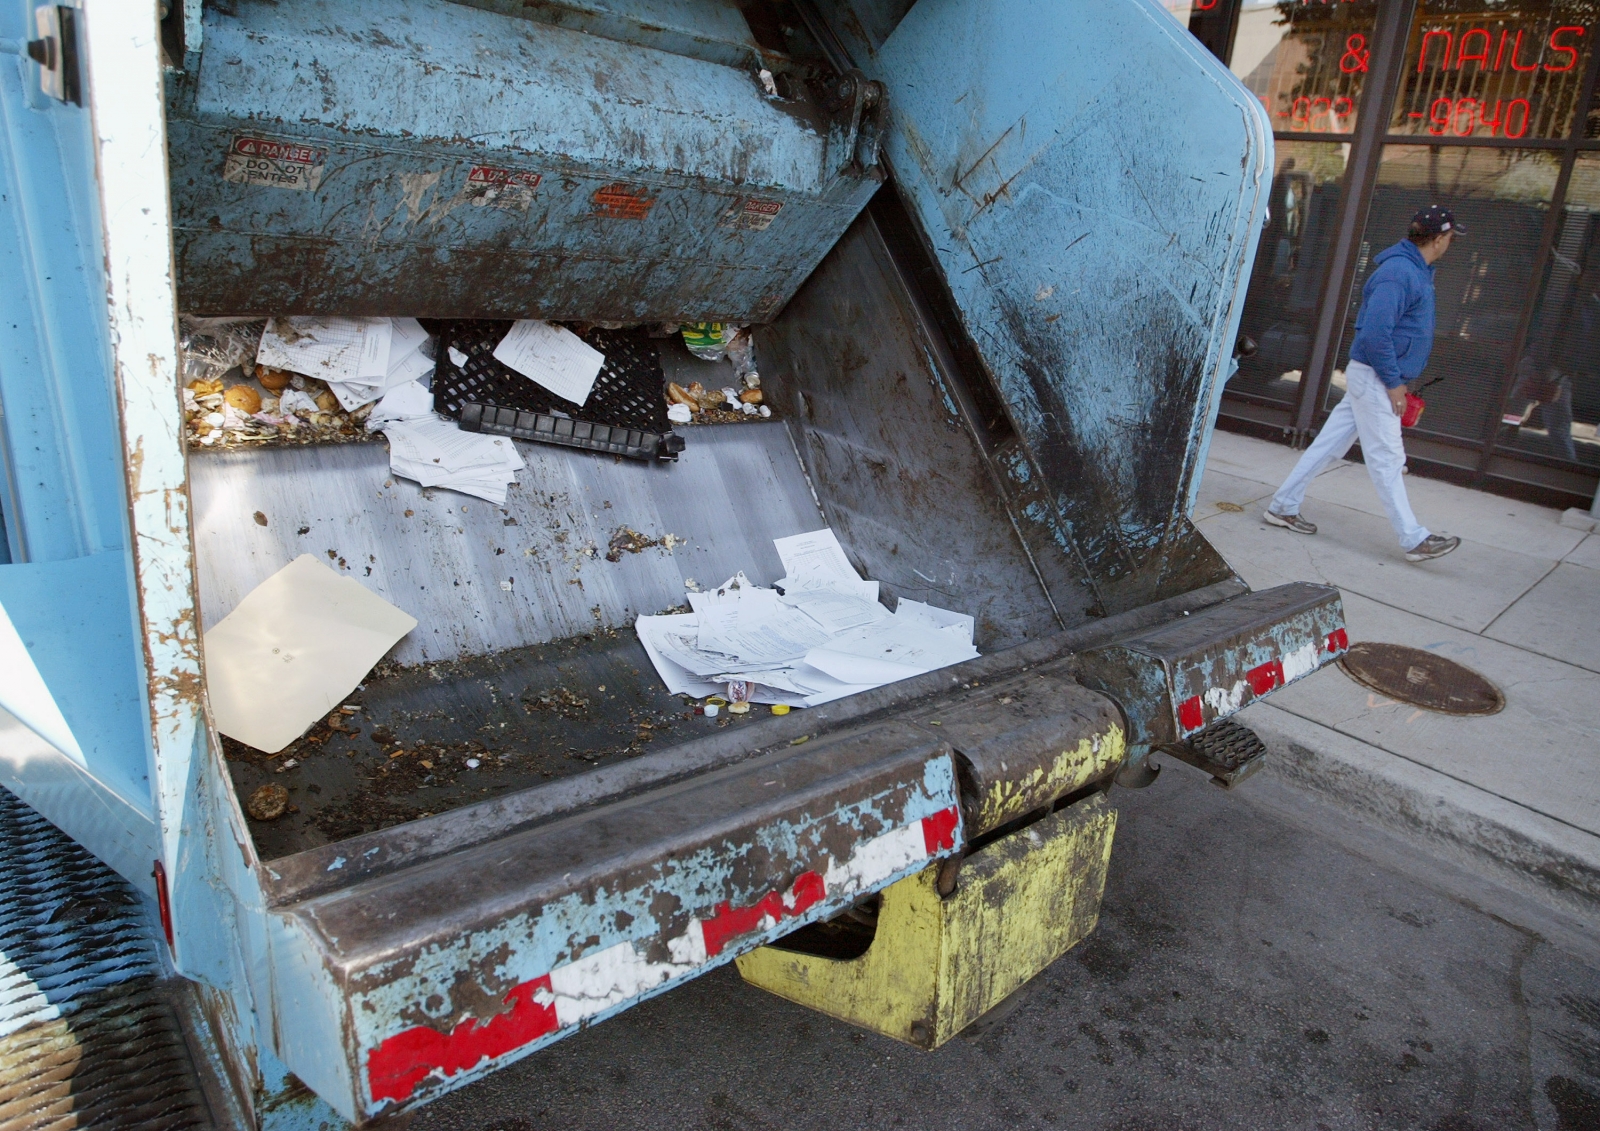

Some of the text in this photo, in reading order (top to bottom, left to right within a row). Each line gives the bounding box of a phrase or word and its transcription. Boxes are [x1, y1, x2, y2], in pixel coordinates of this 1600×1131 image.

[1340, 27, 1584, 73] & NAILS
[246, 160, 269, 171] DO
[745, 201, 777, 213] DANGER
